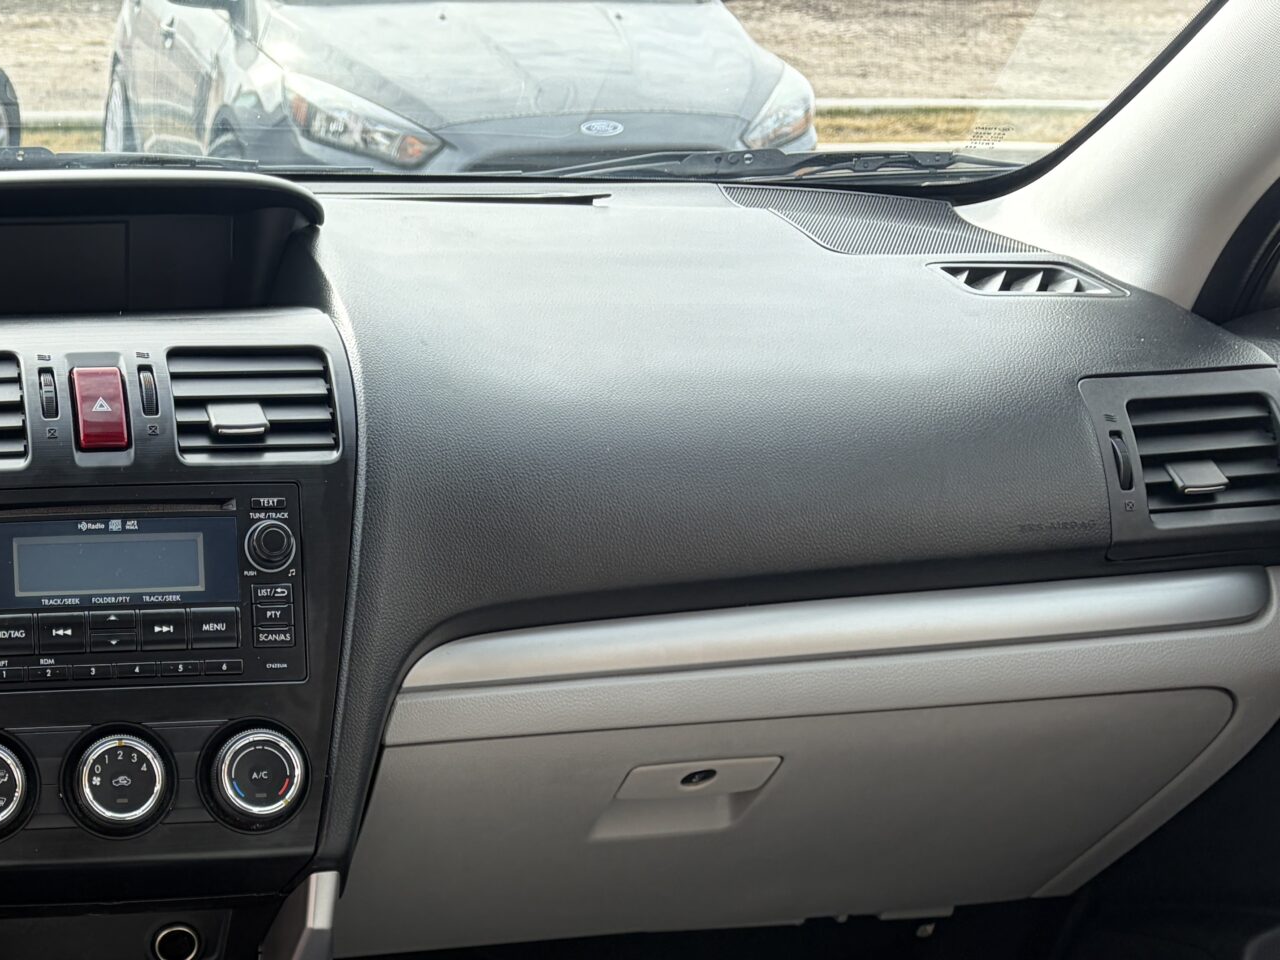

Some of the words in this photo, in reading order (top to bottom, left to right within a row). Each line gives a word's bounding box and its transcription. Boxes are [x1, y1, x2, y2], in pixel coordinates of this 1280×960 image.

[259, 499, 279, 507] TEXT
[249, 512, 289, 520] TUNE/TRACK
[41, 597, 80, 606] TRACK/SEEK
[91, 596, 131, 604] FOLDER/PTY
[141, 594, 181, 602] TRACK/SEEK
[266, 610, 282, 619] PTY
[202, 622, 226, 632] MENU
[104, 754, 109, 764] 1
[116, 750, 124, 760] 2
[131, 753, 138, 763] 3
[94, 764, 102, 774] 0
[140, 762, 148, 772] 4
[252, 771, 268, 780] A/C
